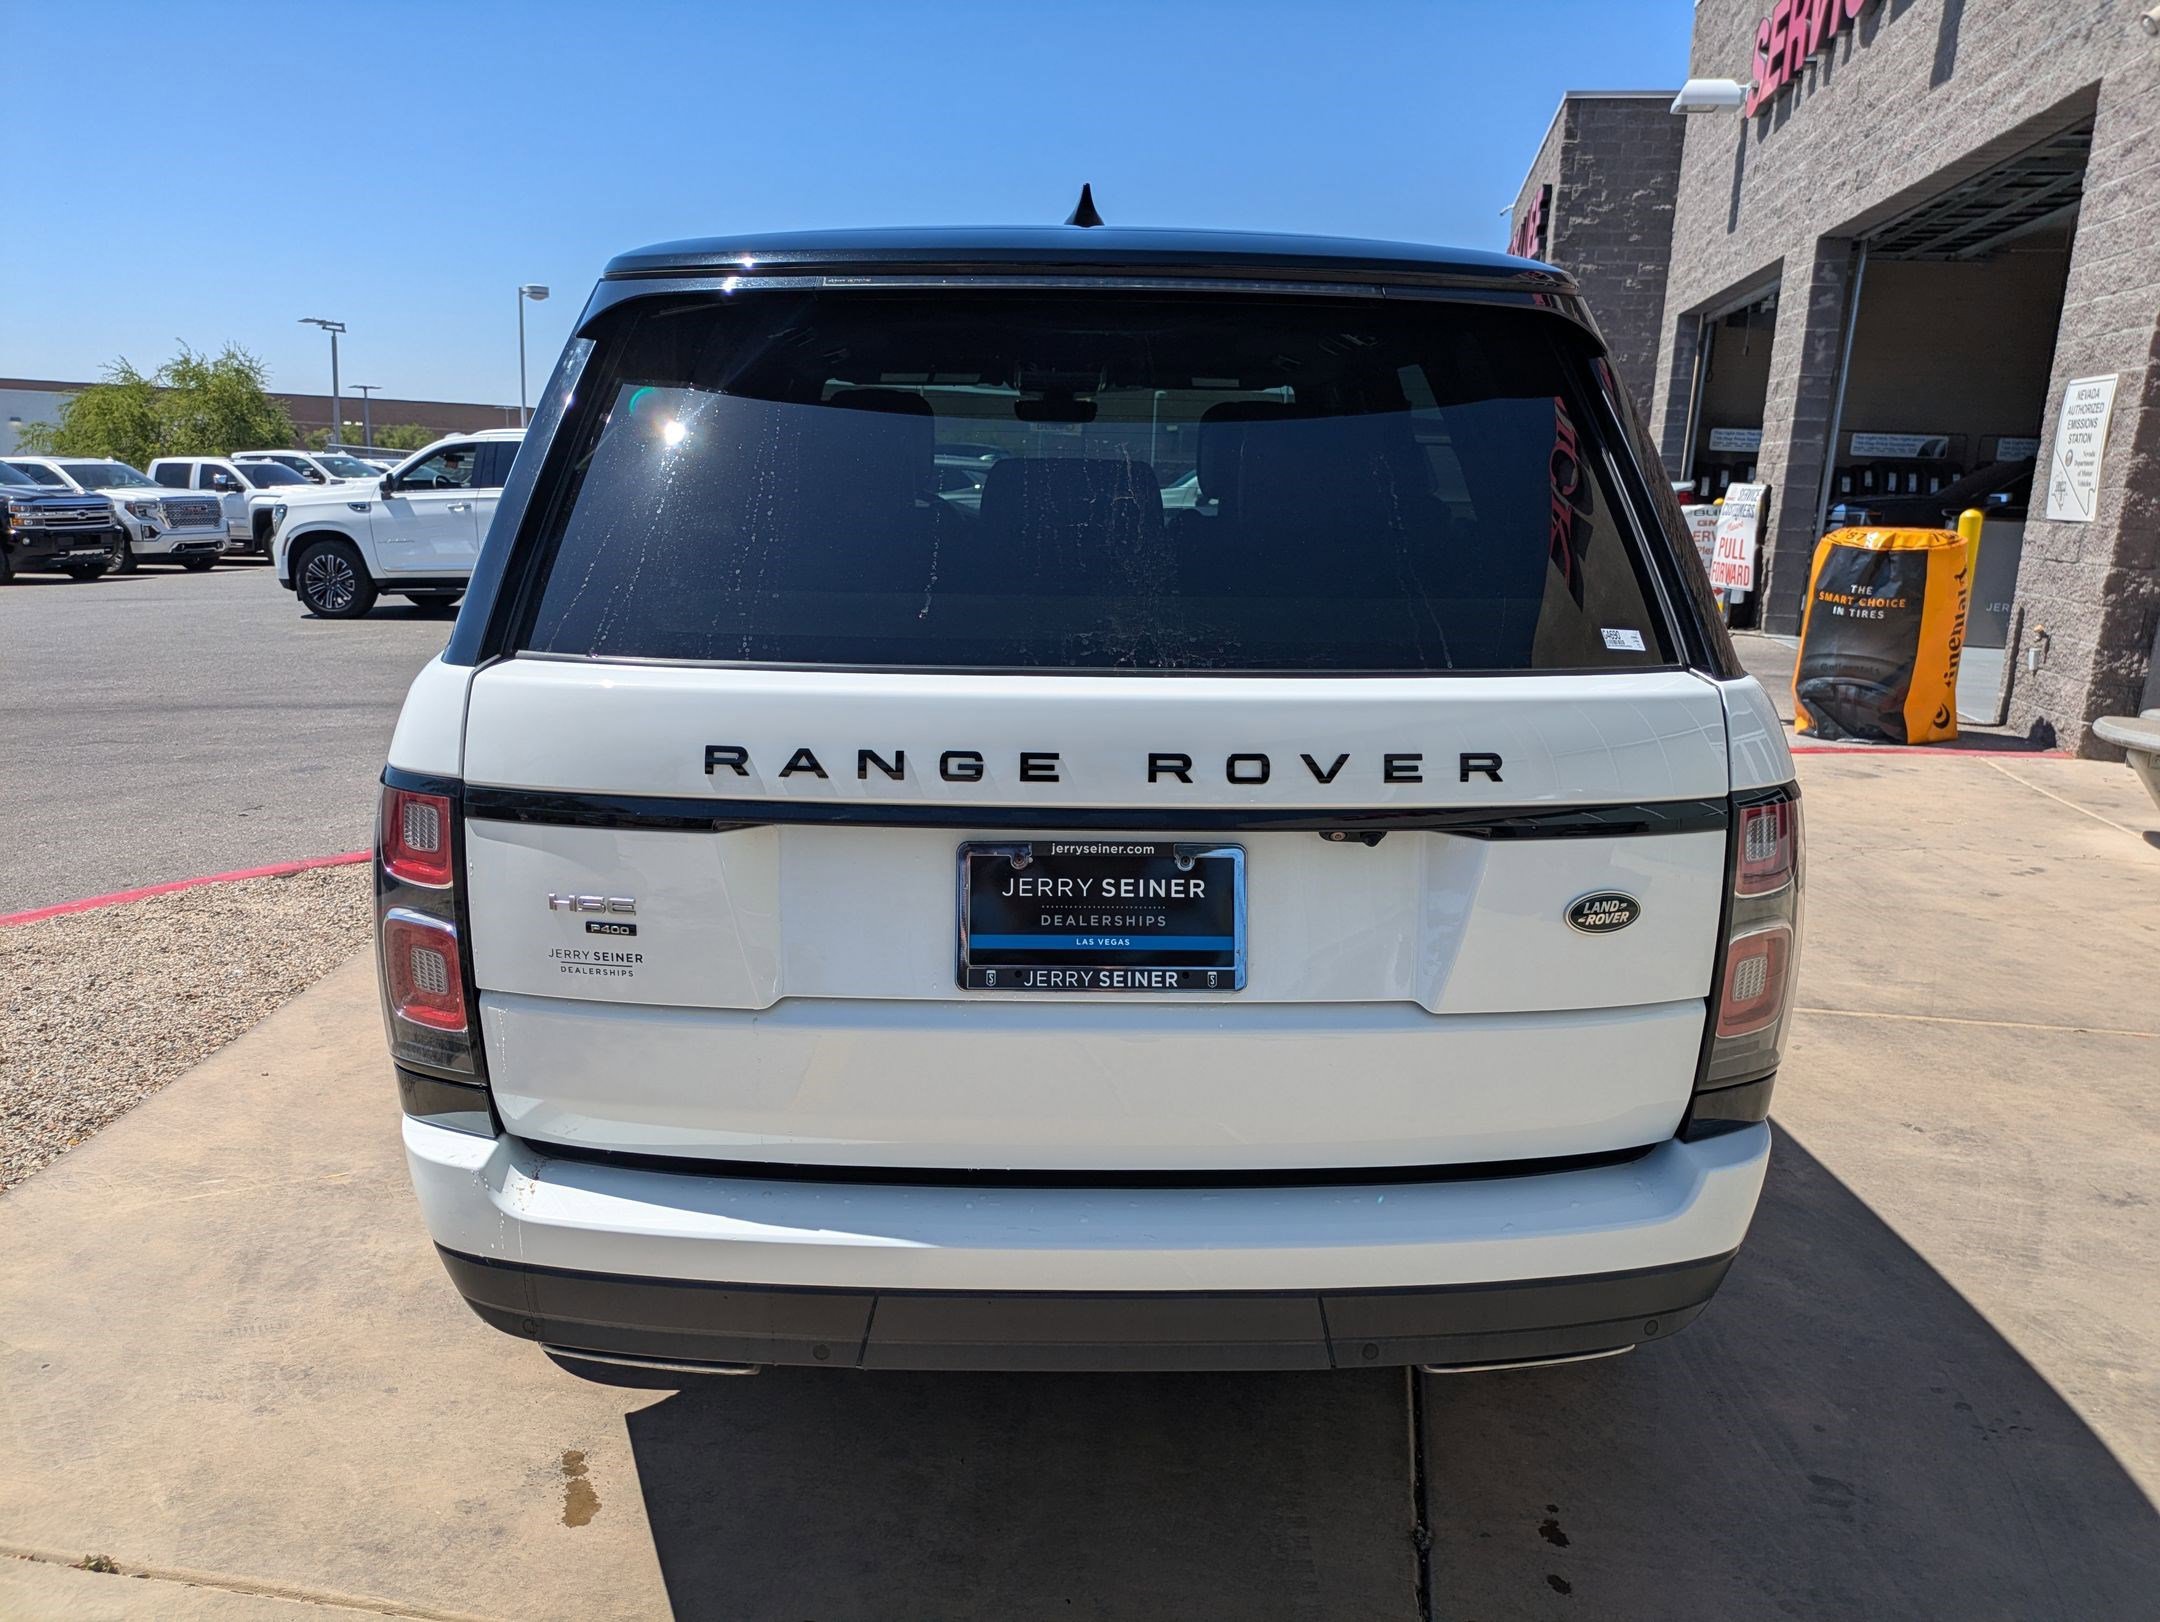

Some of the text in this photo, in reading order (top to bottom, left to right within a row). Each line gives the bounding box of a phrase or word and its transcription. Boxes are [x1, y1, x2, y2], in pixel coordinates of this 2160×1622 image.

[1745, 0, 1865, 119] SERV
[2077, 388, 2100, 400] NEVADA
[2067, 402, 2105, 416] AUTHORIZED
[2067, 417, 2098, 430] EMISSIONS
[2067, 432, 2093, 445] STATION
[1737, 488, 1762, 502] SERVICE
[1721, 503, 1756, 519] CUSTOMERS
[1718, 537, 1745, 561] PULL
[1711, 560, 1750, 587] FORWARD
[1850, 584, 1873, 595] THE
[1818, 591, 1906, 608] SMART CHOICE
[1832, 606, 1885, 619] IN TIRES
[704, 744, 1504, 784] RANGE ROVER
[1051, 843, 1155, 856] jerryseiner.com
[1002, 878, 1206, 898] JERRY SEINER
[548, 893, 636, 916] HSE
[1583, 900, 1619, 914] LAND
[1040, 915, 1166, 927] DEALERSHIPS
[1585, 911, 1630, 925] ROVER
[590, 923, 630, 935] P400
[1076, 938, 1131, 946] LAS VEGAS
[548, 948, 644, 964] JERRY SEINER
[560, 965, 635, 978] DEALERSHIPS
[1023, 971, 1094, 987] JERRY
[1099, 971, 1178, 988] SEINER
